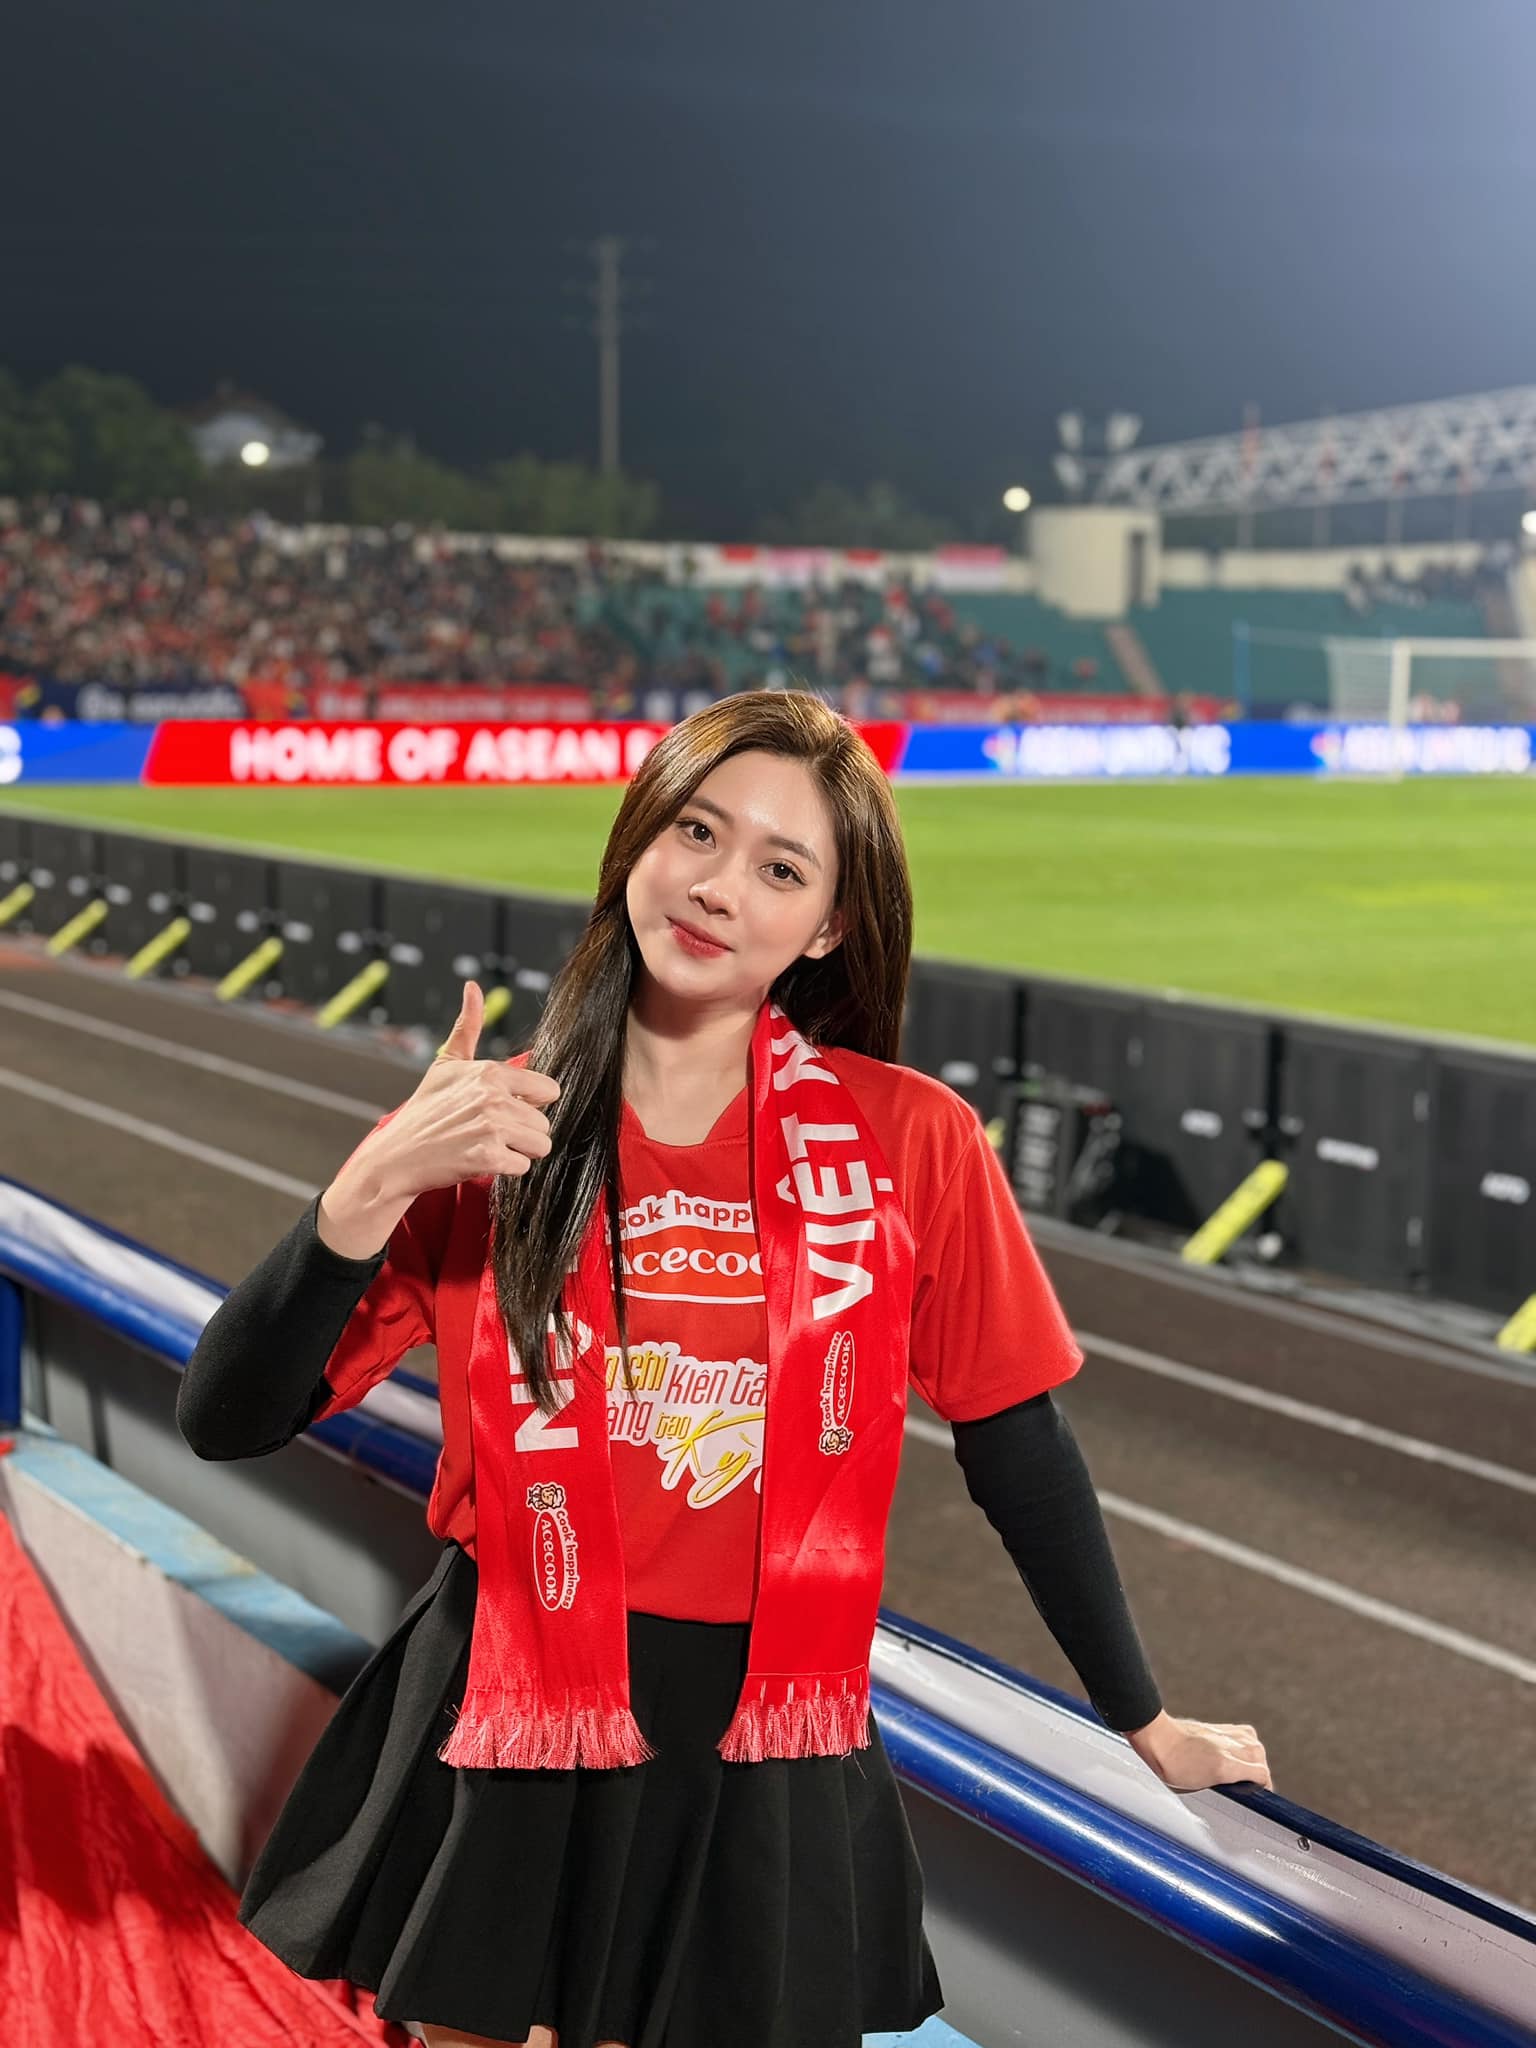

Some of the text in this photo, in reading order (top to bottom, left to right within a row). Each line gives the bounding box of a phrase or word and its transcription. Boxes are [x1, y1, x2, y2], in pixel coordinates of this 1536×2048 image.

[229, 728, 381, 781] HOME
[388, 727, 458, 781] OF
[464, 728, 620, 780] ASEAN
[675, 1196, 751, 1228] happ
[776, 1113, 894, 1321] VIỆT
[730, 1366, 767, 1407] tâ
[607, 1401, 654, 1441] àng
